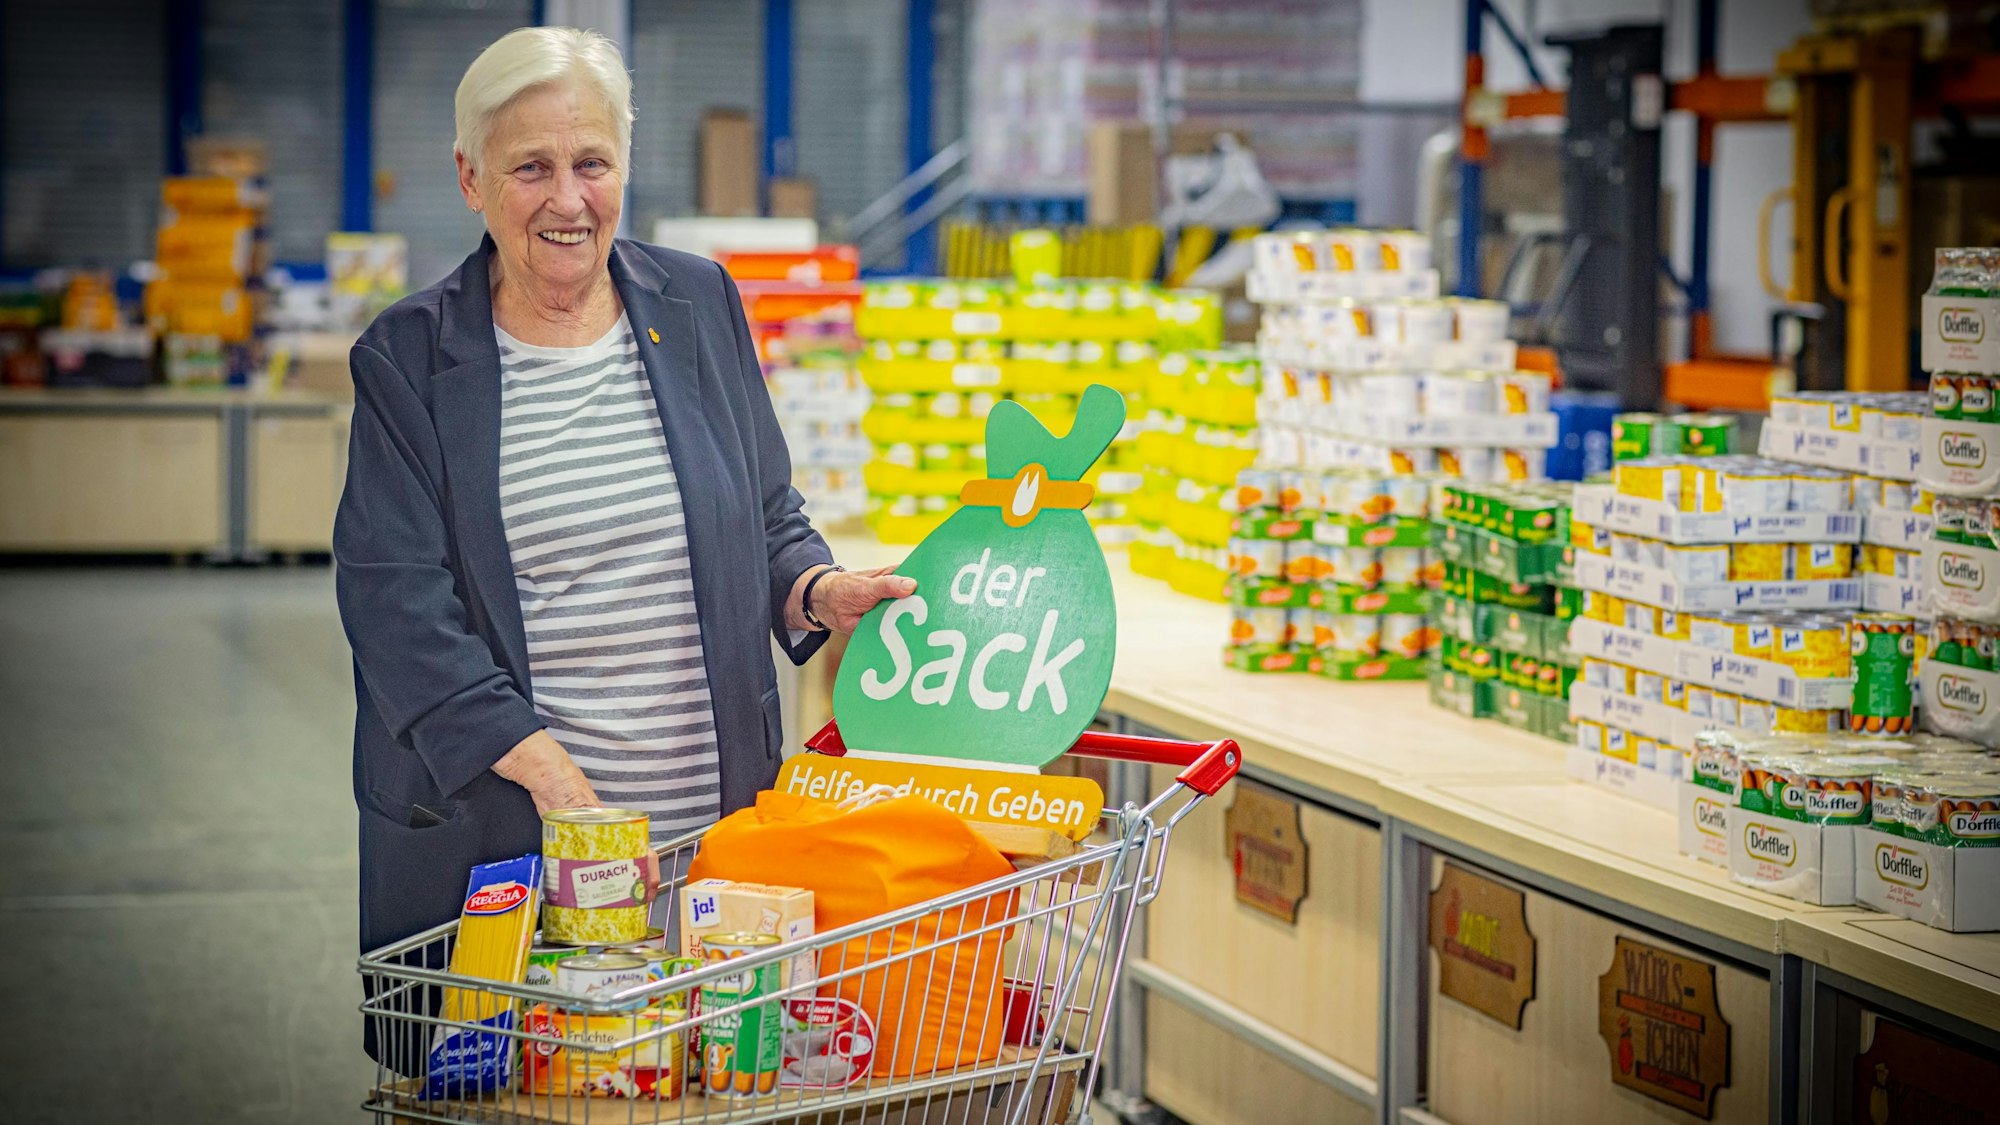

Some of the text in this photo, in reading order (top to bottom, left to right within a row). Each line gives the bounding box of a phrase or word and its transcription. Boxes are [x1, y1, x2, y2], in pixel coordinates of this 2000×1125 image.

[950, 547, 1047, 608] der
[860, 595, 1086, 716] Sack
[787, 765, 880, 802] Helfe
[988, 786, 1085, 826] Geben
[1957, 811, 2000, 831] Dörffle
[1751, 824, 1789, 857] Dörffler
[580, 864, 629, 884] DURACH
[1882, 846, 1922, 879] Dörffler
[470, 889, 521, 908] REGGIA
[692, 897, 715, 922] ja!
[602, 977, 614, 986] LA
